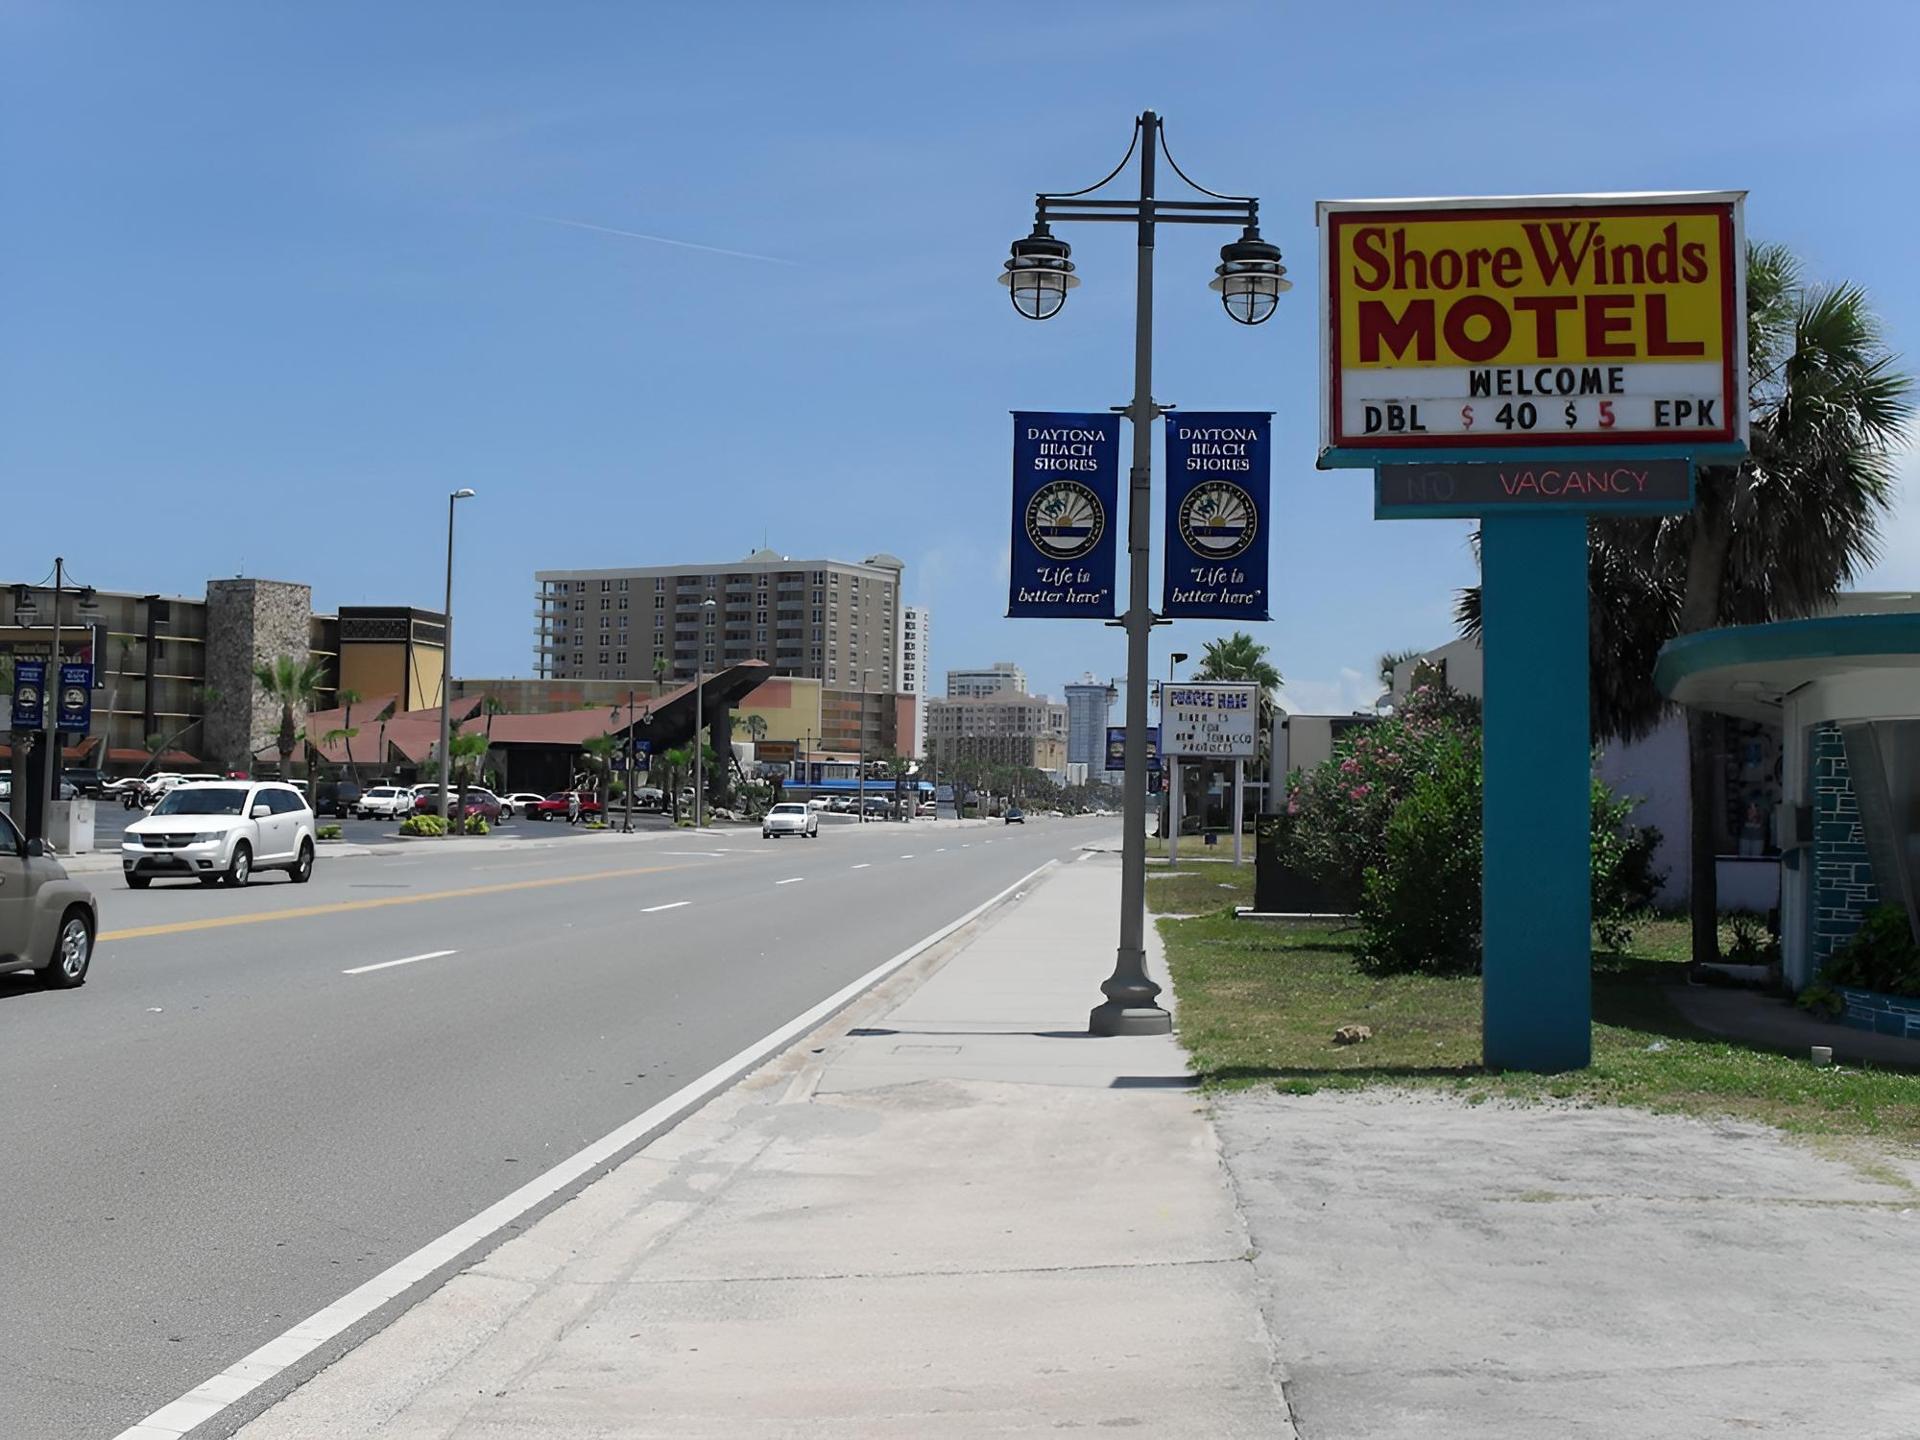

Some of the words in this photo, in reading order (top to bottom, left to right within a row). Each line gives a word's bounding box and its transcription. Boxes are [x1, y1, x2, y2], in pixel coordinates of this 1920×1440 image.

[1358, 293, 1706, 363] MOTEL
[1469, 366, 1625, 398] WELCOME
[1363, 404, 1427, 434] DBL
[1494, 401, 1538, 430] 40
[1598, 400, 1616, 429] 5
[1027, 427, 1106, 442] DAYTONA
[1179, 427, 1258, 441] DAYTONA
[1040, 443, 1093, 456] BEACH
[1191, 442, 1246, 456] BEACH
[1034, 457, 1098, 471] SHORES
[1186, 457, 1250, 471] SHORES
[1500, 468, 1650, 496] VACANCY
[1018, 586, 1064, 603] better
[1171, 586, 1218, 603] better
